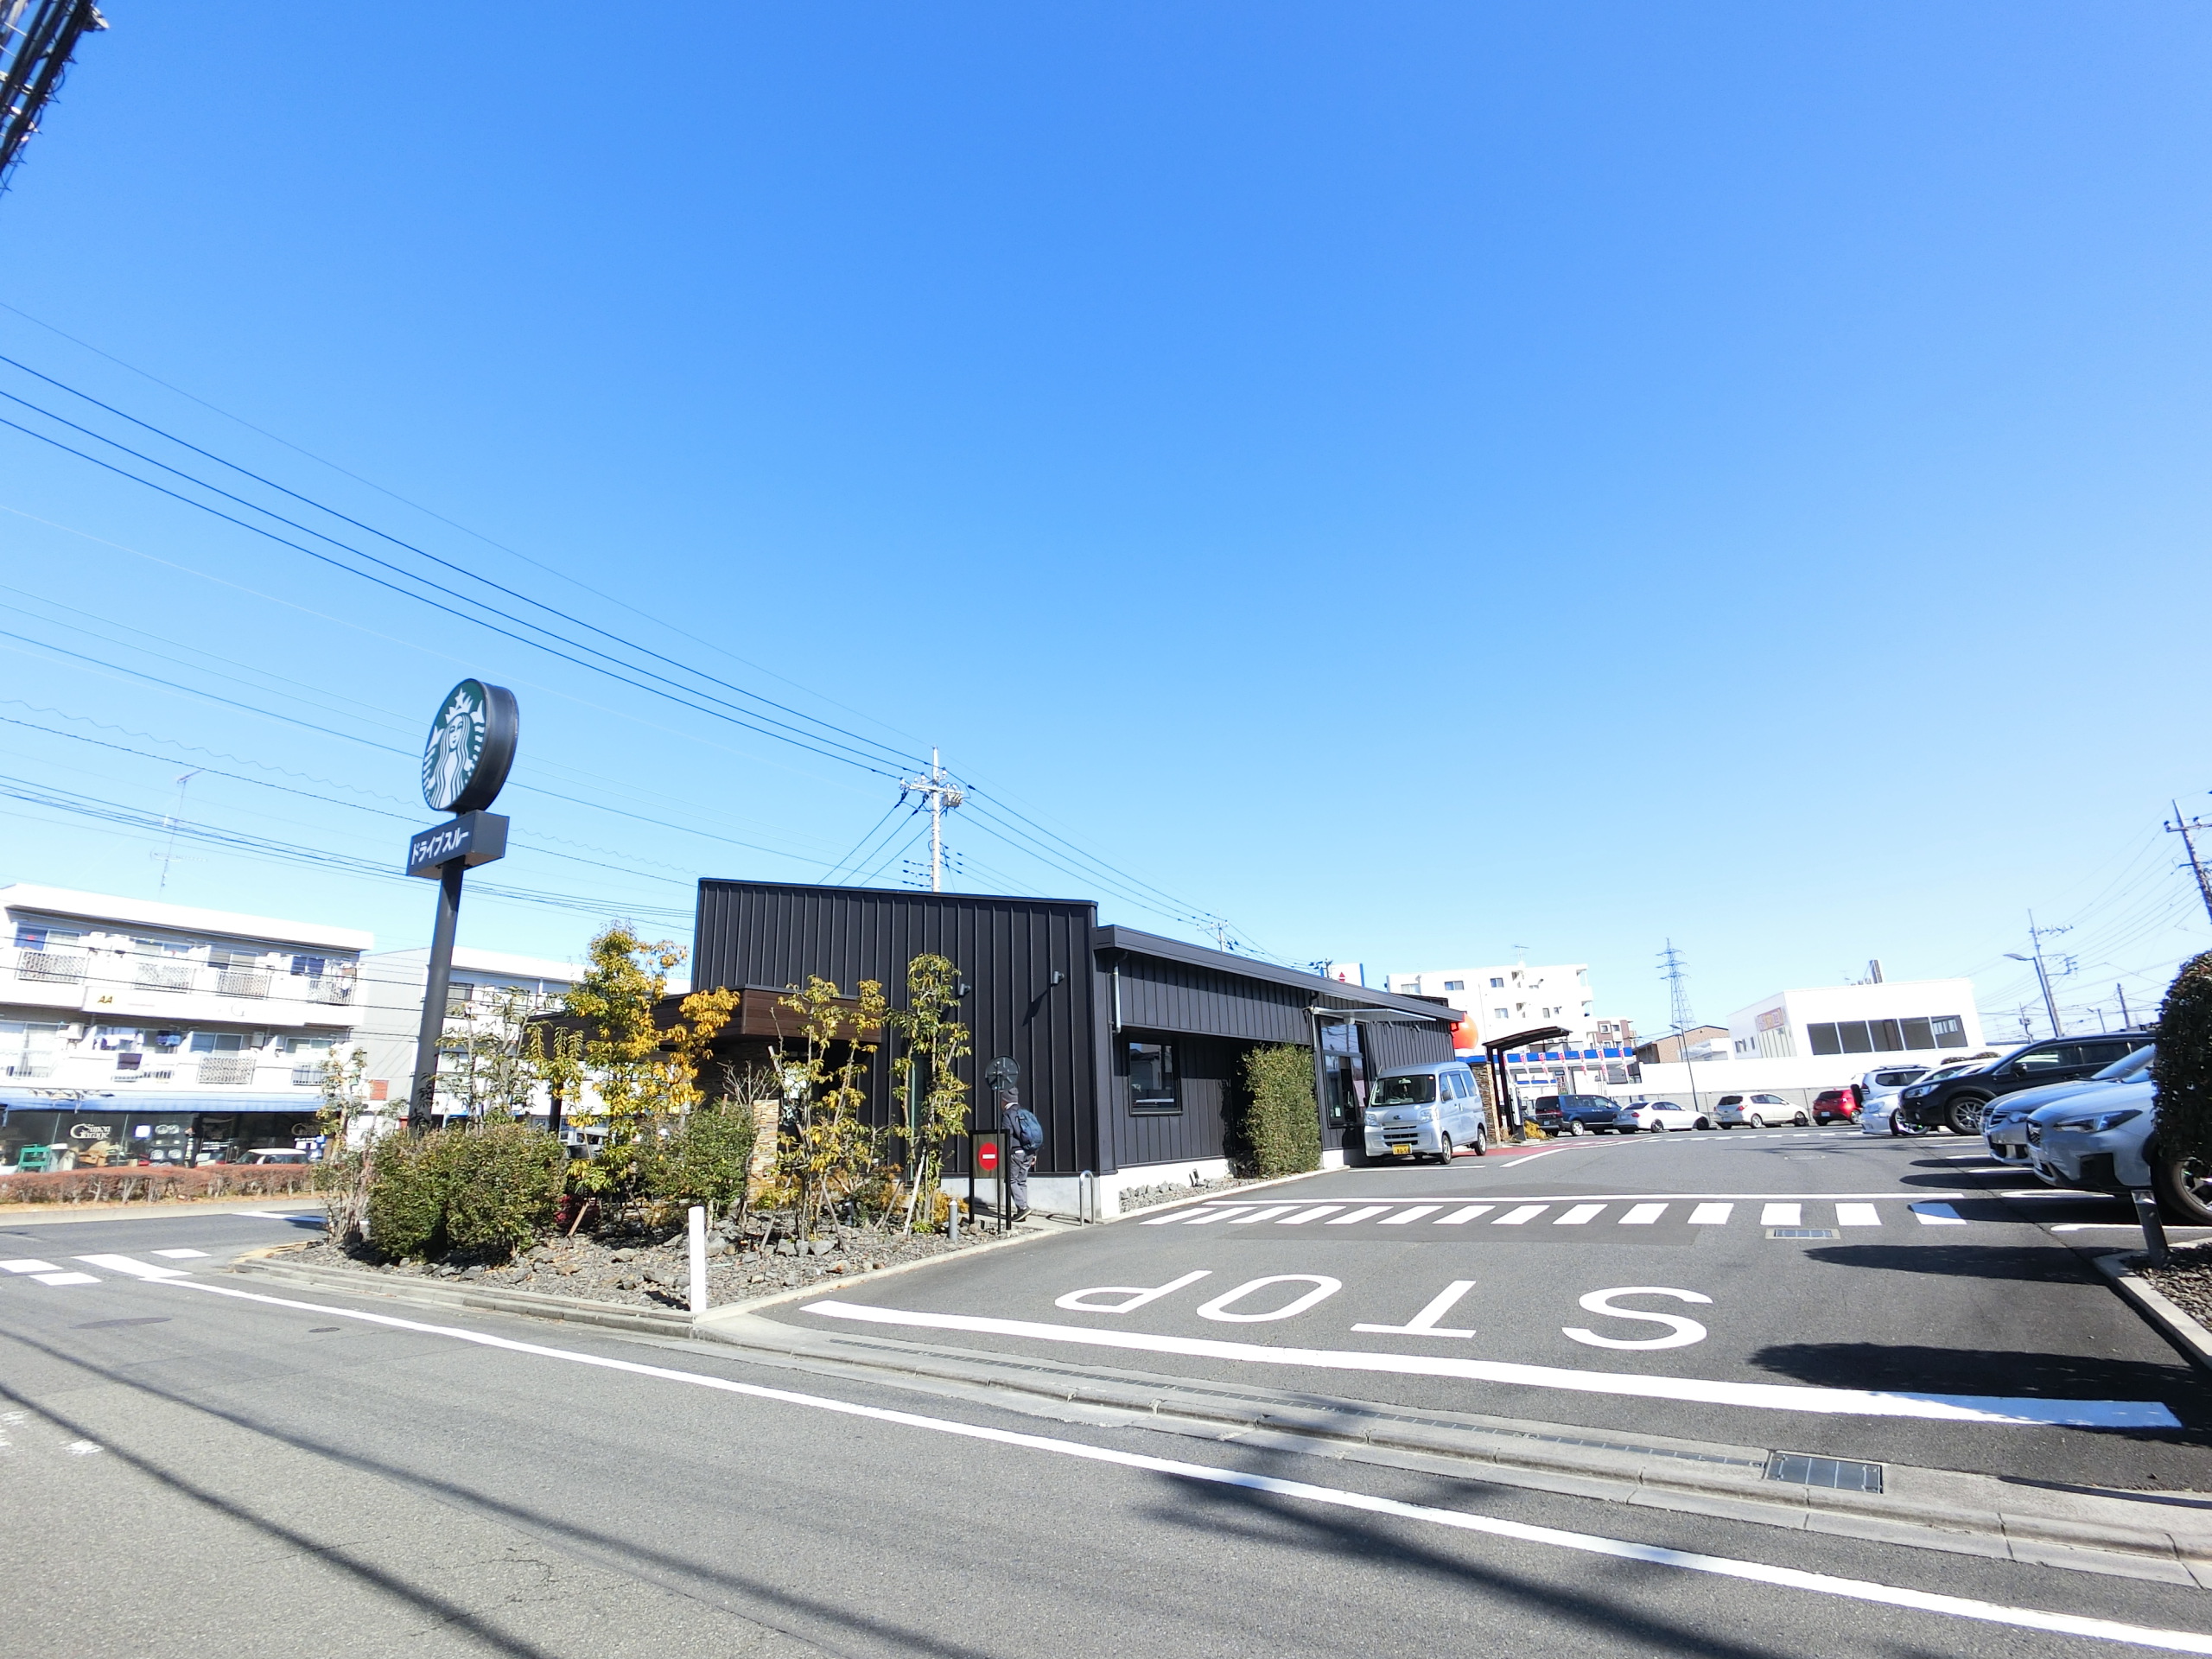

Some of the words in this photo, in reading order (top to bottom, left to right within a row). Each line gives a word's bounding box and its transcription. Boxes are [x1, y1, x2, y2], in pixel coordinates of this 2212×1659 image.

[411, 827, 469, 866] ドライブスルー
[1055, 1269, 1713, 1351] STOP
